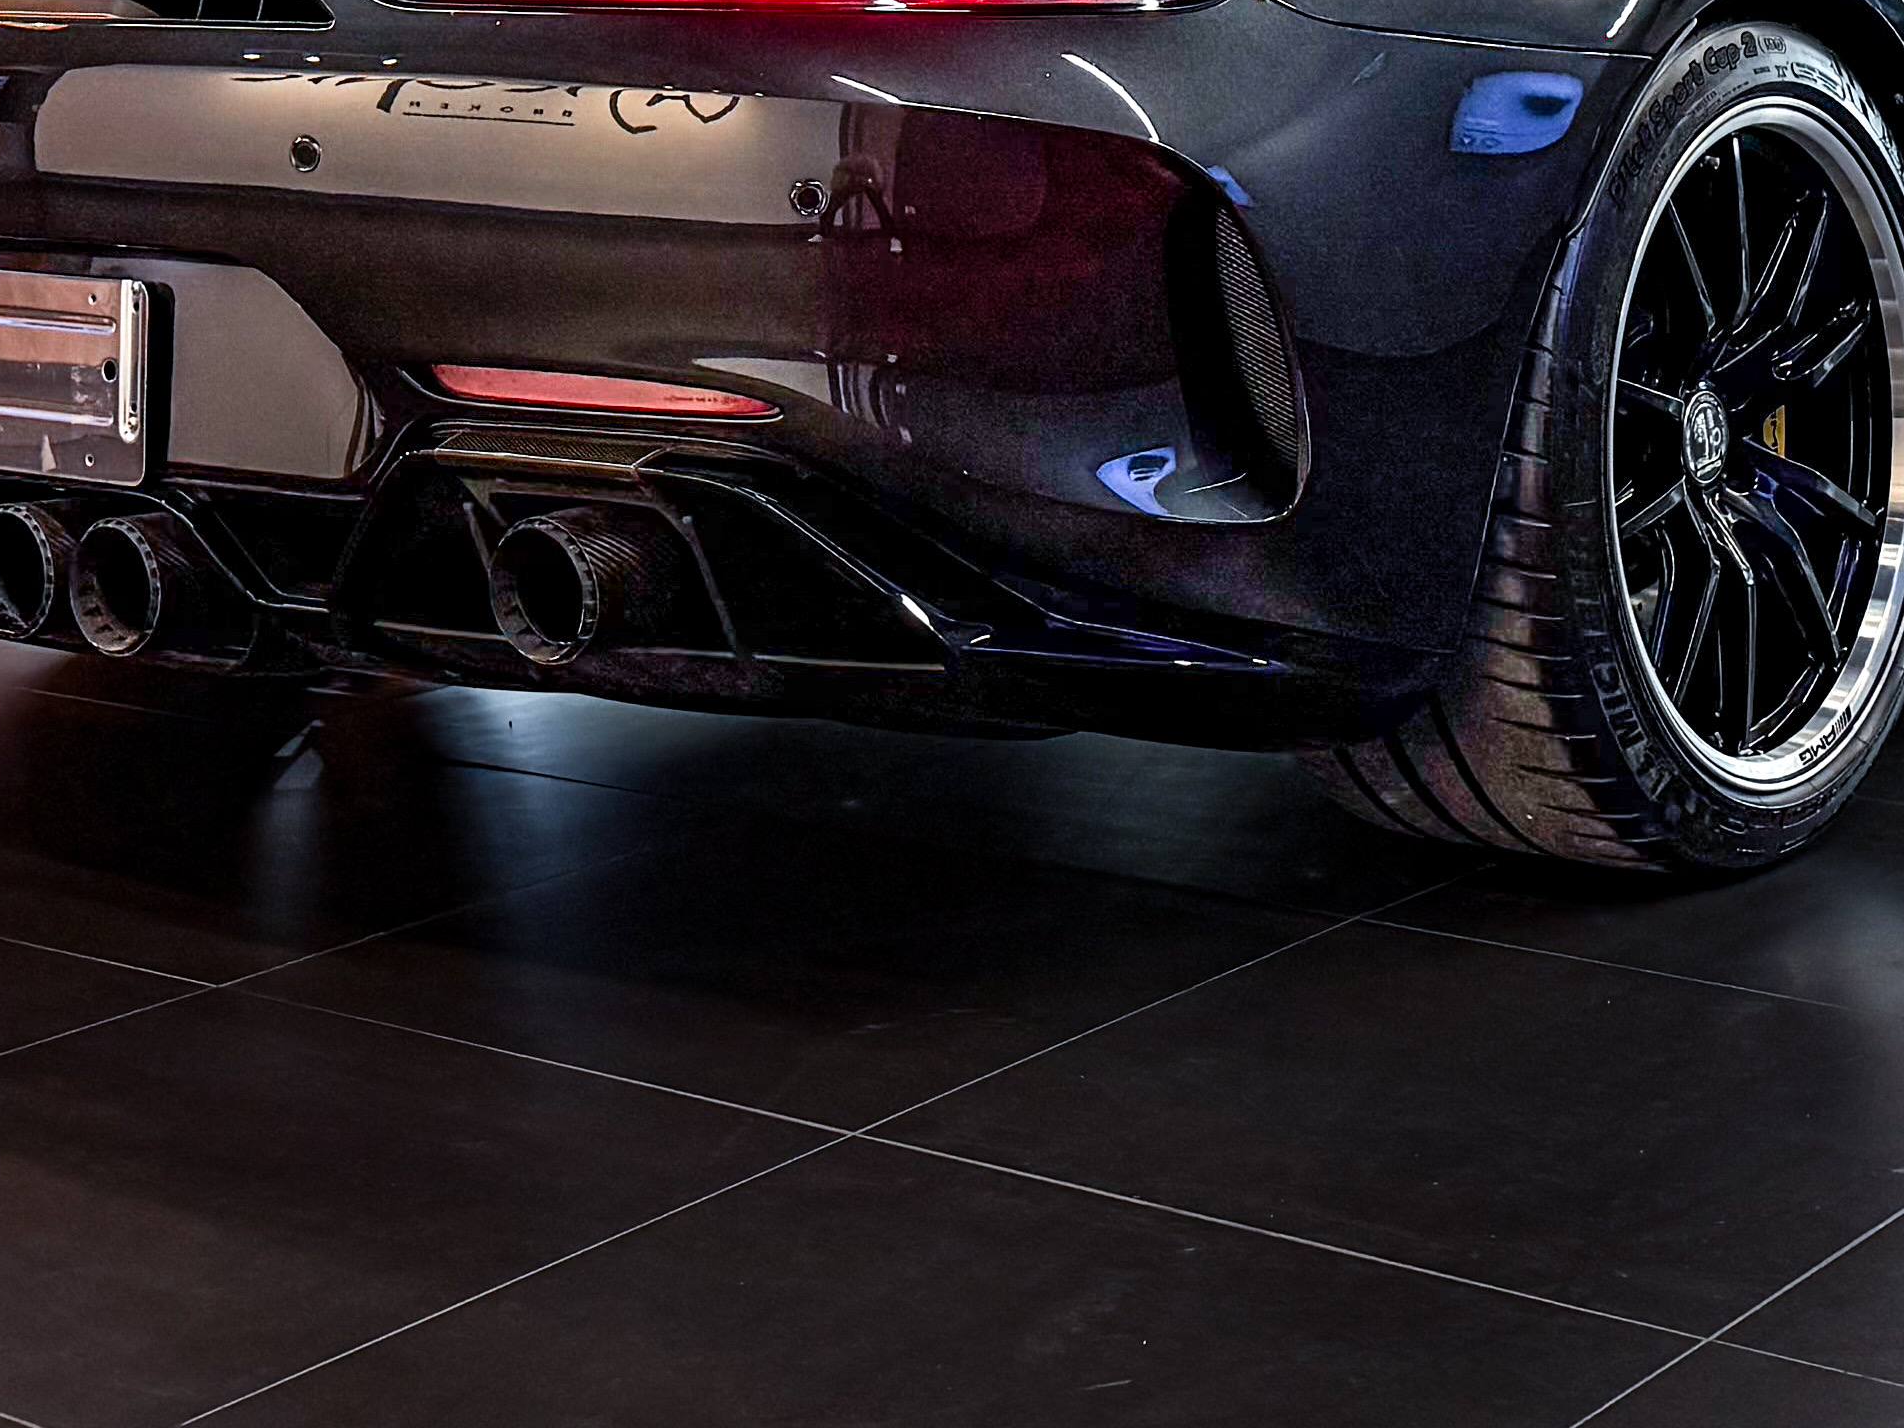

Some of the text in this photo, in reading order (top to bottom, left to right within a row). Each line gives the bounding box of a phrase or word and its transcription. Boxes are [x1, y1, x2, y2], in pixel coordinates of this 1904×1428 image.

[1647, 60, 1706, 136] Sport
[1703, 43, 1741, 75] Cup
[1741, 31, 1758, 58] 2
